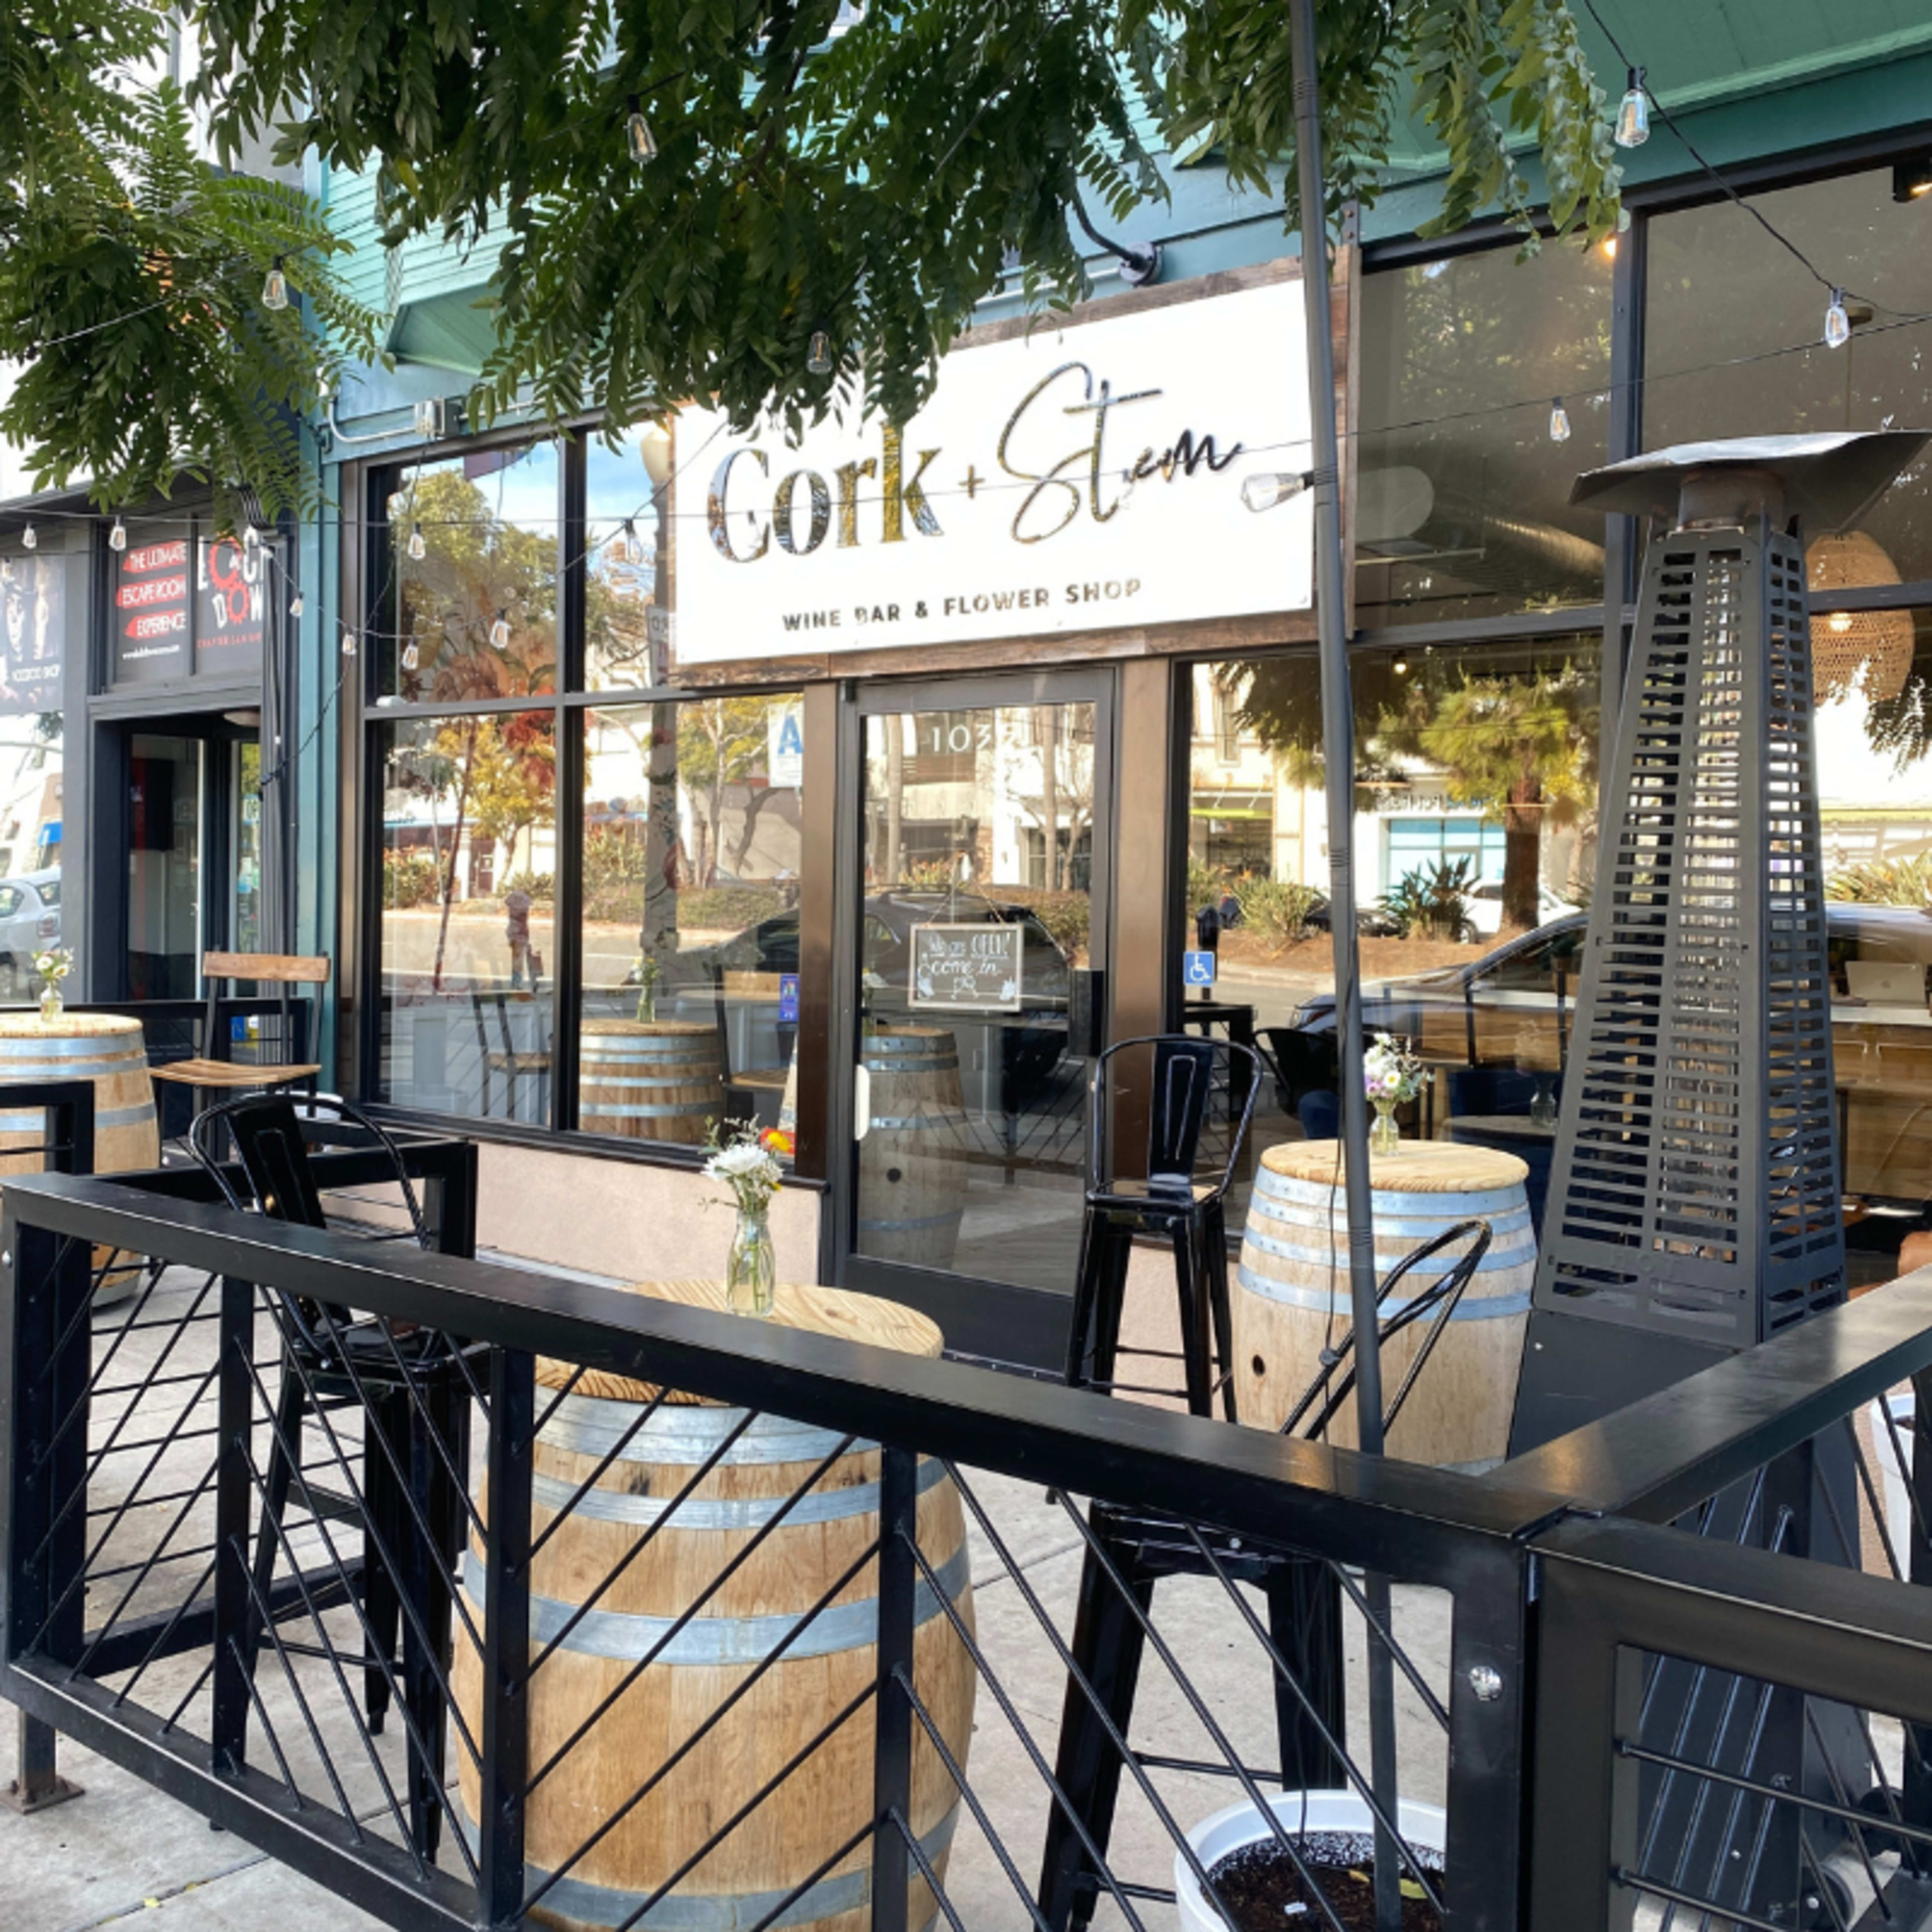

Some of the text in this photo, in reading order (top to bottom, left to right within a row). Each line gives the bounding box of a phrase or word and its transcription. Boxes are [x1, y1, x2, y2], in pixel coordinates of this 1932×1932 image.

[707, 361, 1242, 563] Cork + Stem
[130, 542, 186, 570] THE ULTIMATE
[122, 578, 186, 605] ESCAPE ROOM
[212, 584, 263, 629] DOW
[782, 578, 1141, 631] WINE BAR & FLOWER SHOP
[137, 611, 186, 636] EXPERIENCE
[778, 714, 803, 754] A
[931, 960, 975, 976] come
